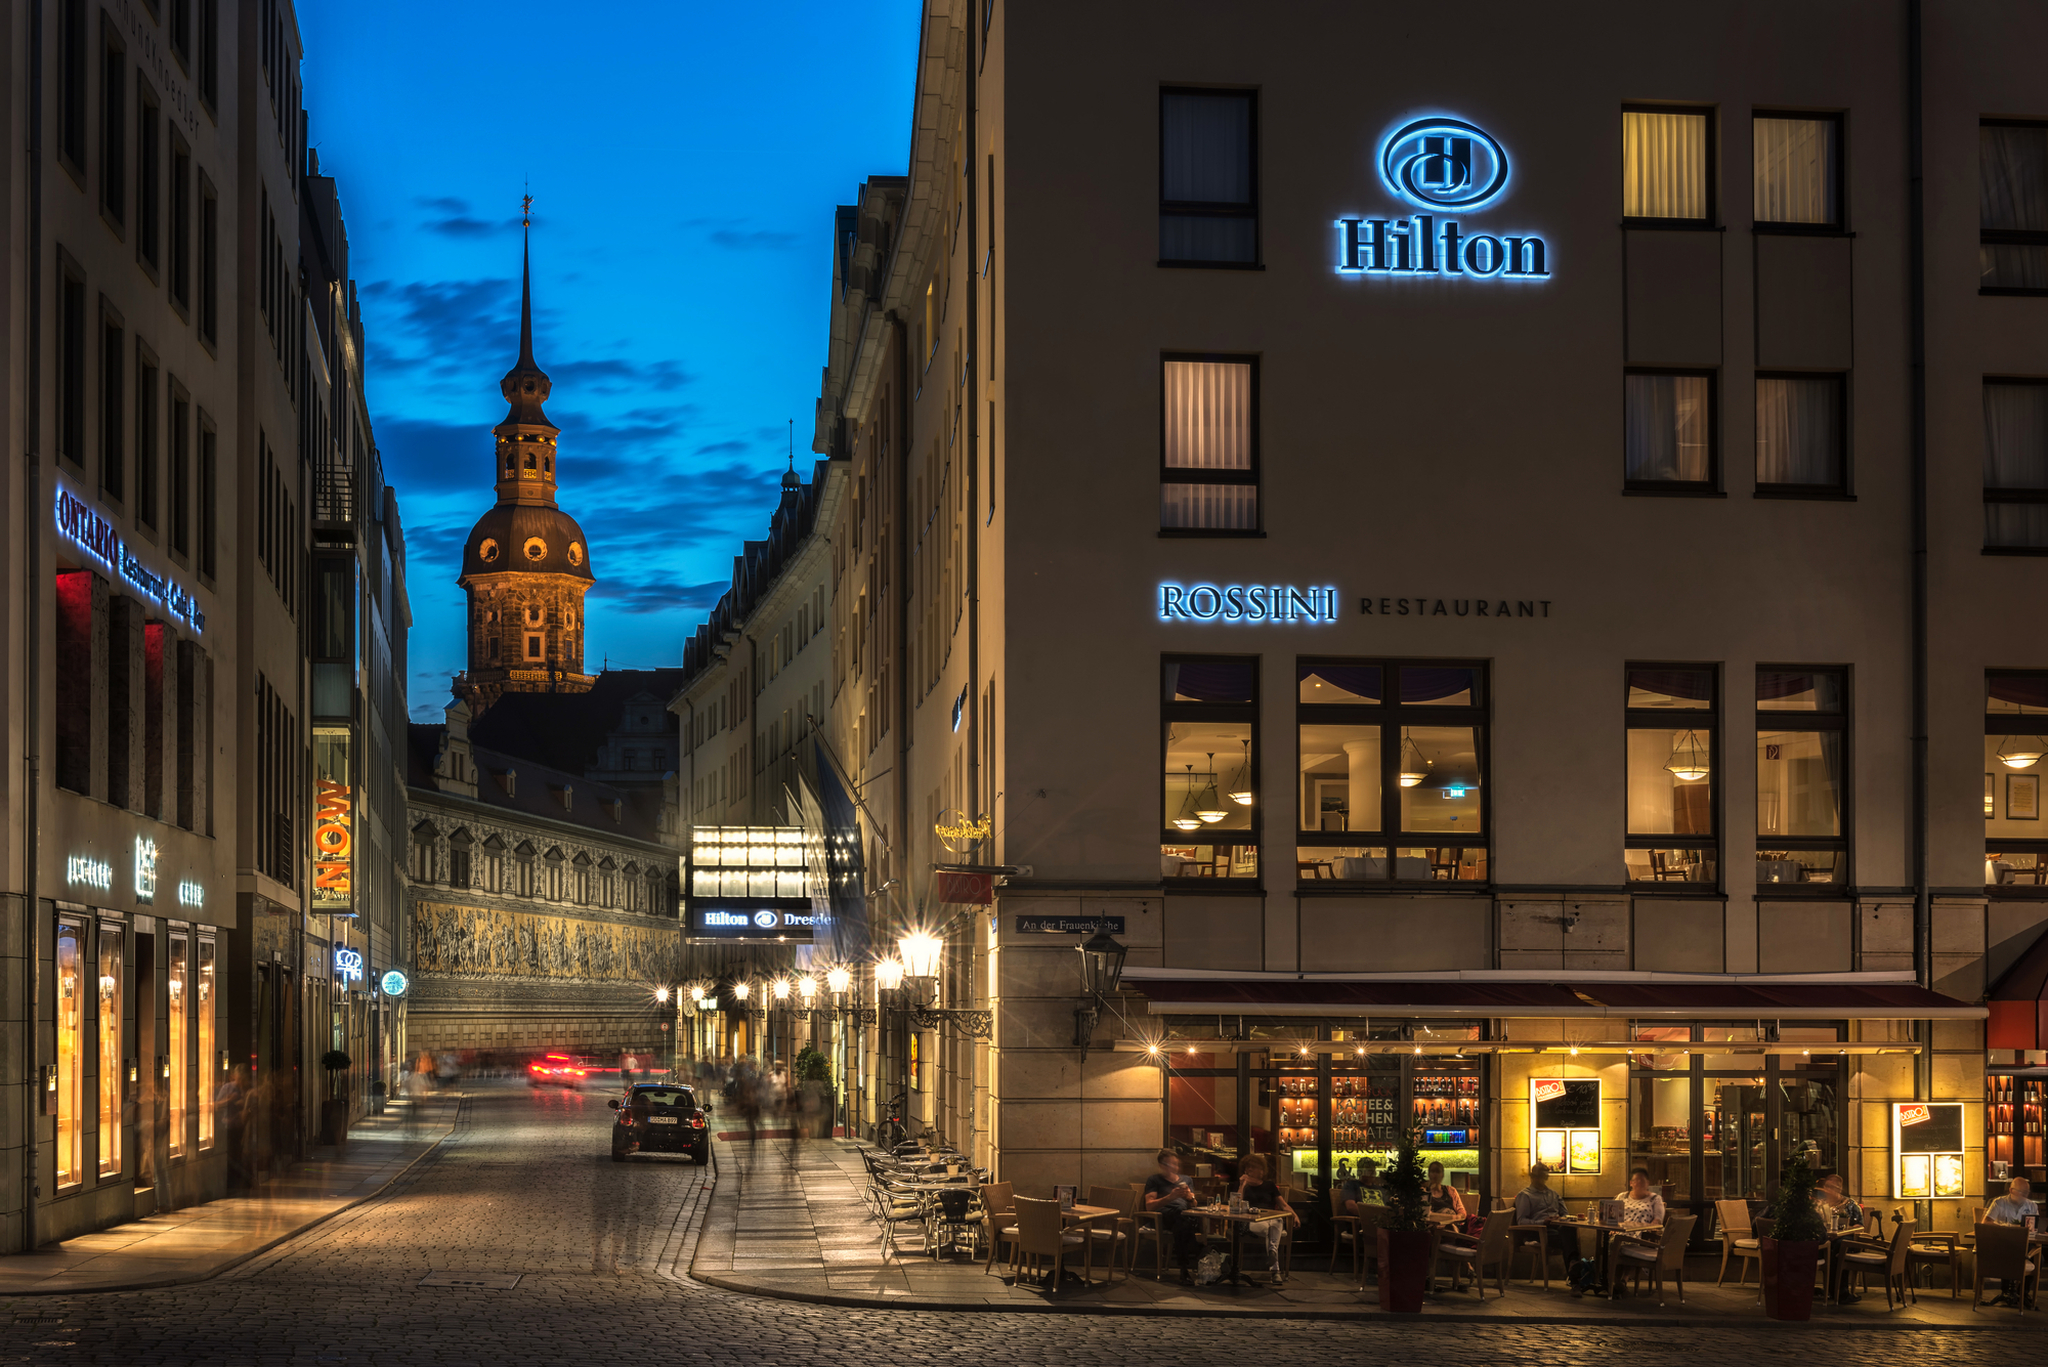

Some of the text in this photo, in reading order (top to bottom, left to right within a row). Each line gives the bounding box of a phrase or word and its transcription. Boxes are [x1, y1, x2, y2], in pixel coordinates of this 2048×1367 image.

[1336, 214, 1551, 278] Hilton
[57, 488, 119, 567] ONTARIO
[121, 543, 166, 601] Restaurant
[1159, 585, 1552, 622] ROSSINI RESTAURANT
[315, 778, 350, 889] NOW
[946, 875, 982, 895] BISTRO
[704, 911, 841, 926] Hilton Dresden
[1022, 920, 1119, 931] An der Frauenkihe
[1336, 1112, 1394, 1125] KUCHEN
[1336, 1141, 1394, 1154] BURGER
